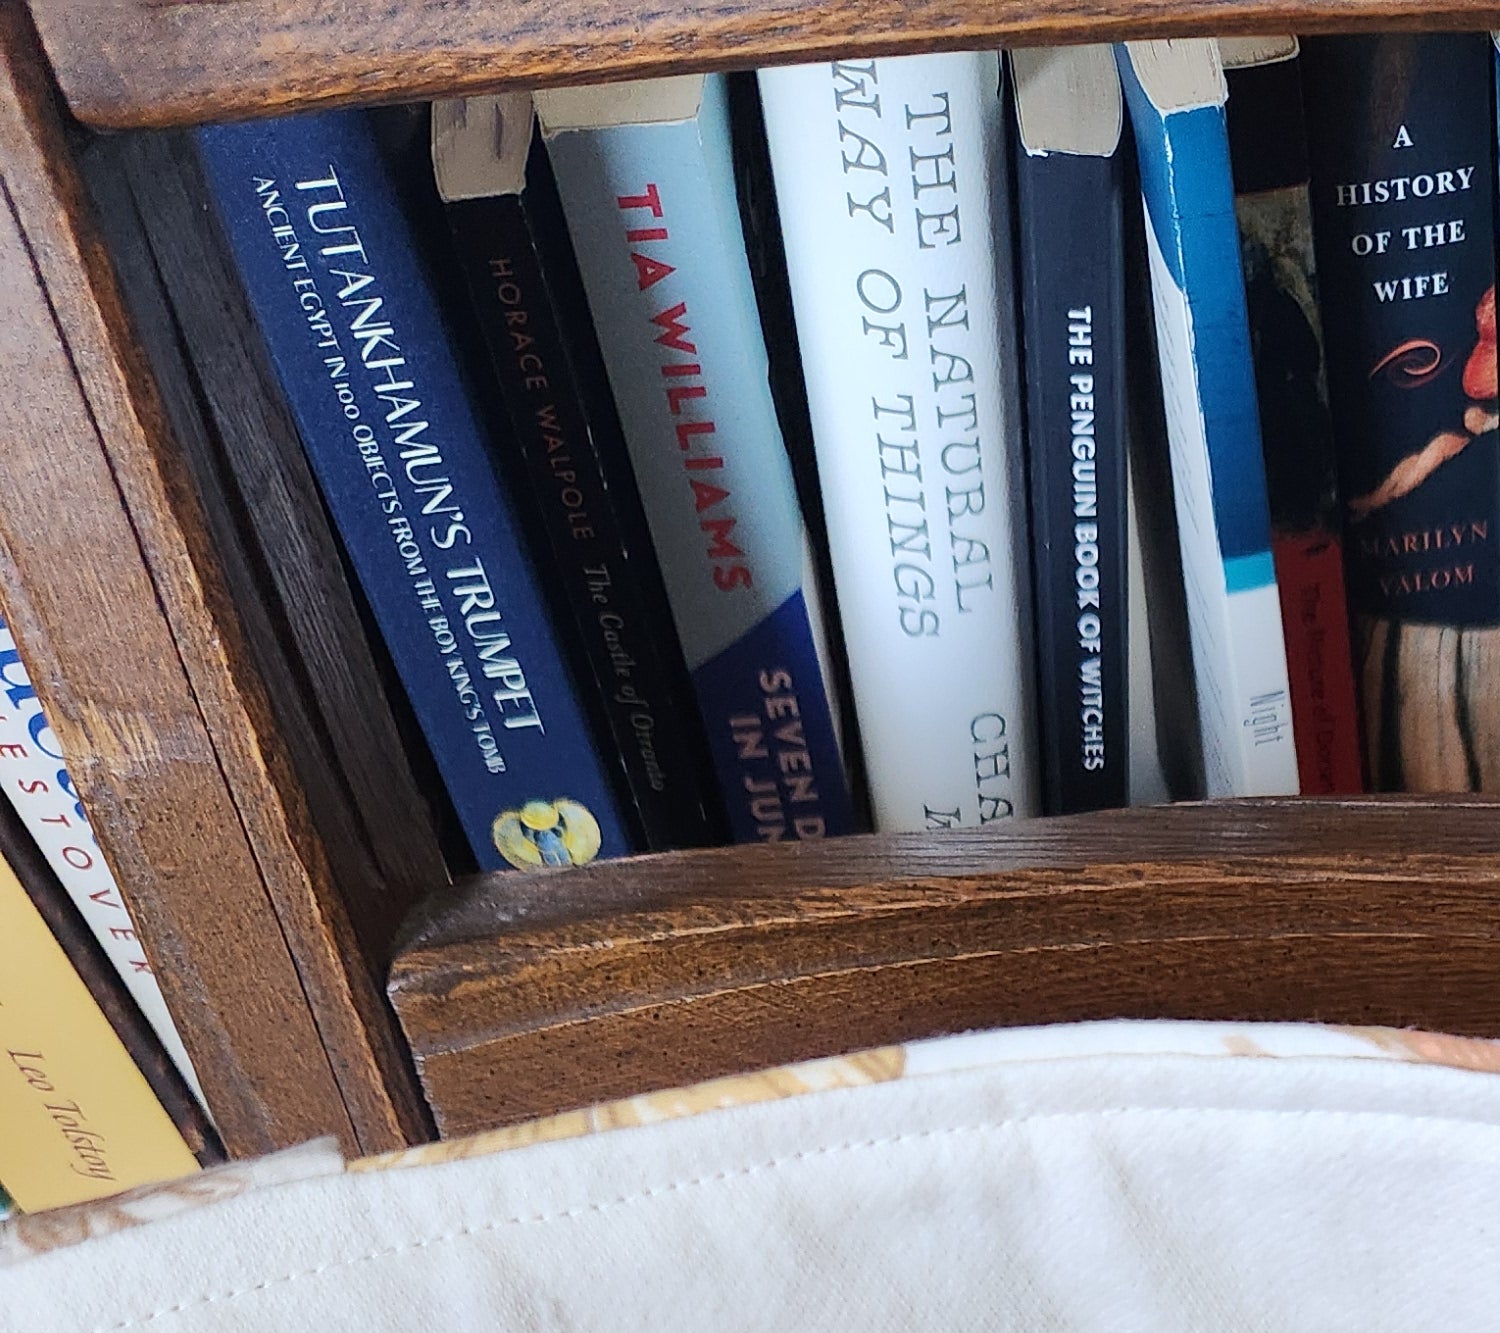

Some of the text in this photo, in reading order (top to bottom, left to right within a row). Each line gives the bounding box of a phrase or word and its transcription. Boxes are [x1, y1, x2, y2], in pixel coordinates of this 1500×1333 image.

[1336, 166, 1476, 207] HISTORY
[1392, 124, 1415, 149] A
[1351, 219, 1467, 257] OF THE
[1372, 271, 1450, 303] WIFE
[489, 256, 549, 391] HORACE
[831, 60, 941, 639] WAY OF THINGS
[904, 91, 994, 615] THE NATURAL
[616, 183, 754, 593] TIA WILLIAMS
[252, 175, 508, 775] ANCIENT EGYPT IN 100 OBJECTS FROM THE BOY KING'S TOMB
[294, 163, 546, 736] TUTANKHAMUN'S TRUMPET
[534, 403, 596, 543] WALPOLE
[582, 562, 612, 605] The
[1066, 305, 1105, 772] THE PENGUIN BOOK OF WITCHES
[1359, 520, 1489, 558] MARILYN
[1379, 562, 1476, 598] YALOM
[600, 613, 638, 678] Castle
[615, 684, 650, 708] of
[729, 715, 770, 760] IN
[758, 667, 820, 802] SEVEN
[970, 712, 1014, 825] CHA
[1243, 690, 1289, 747] Night
[0, 714, 153, 975] ESTOVER
[6, 1049, 118, 1182] Leo Tolstoy
